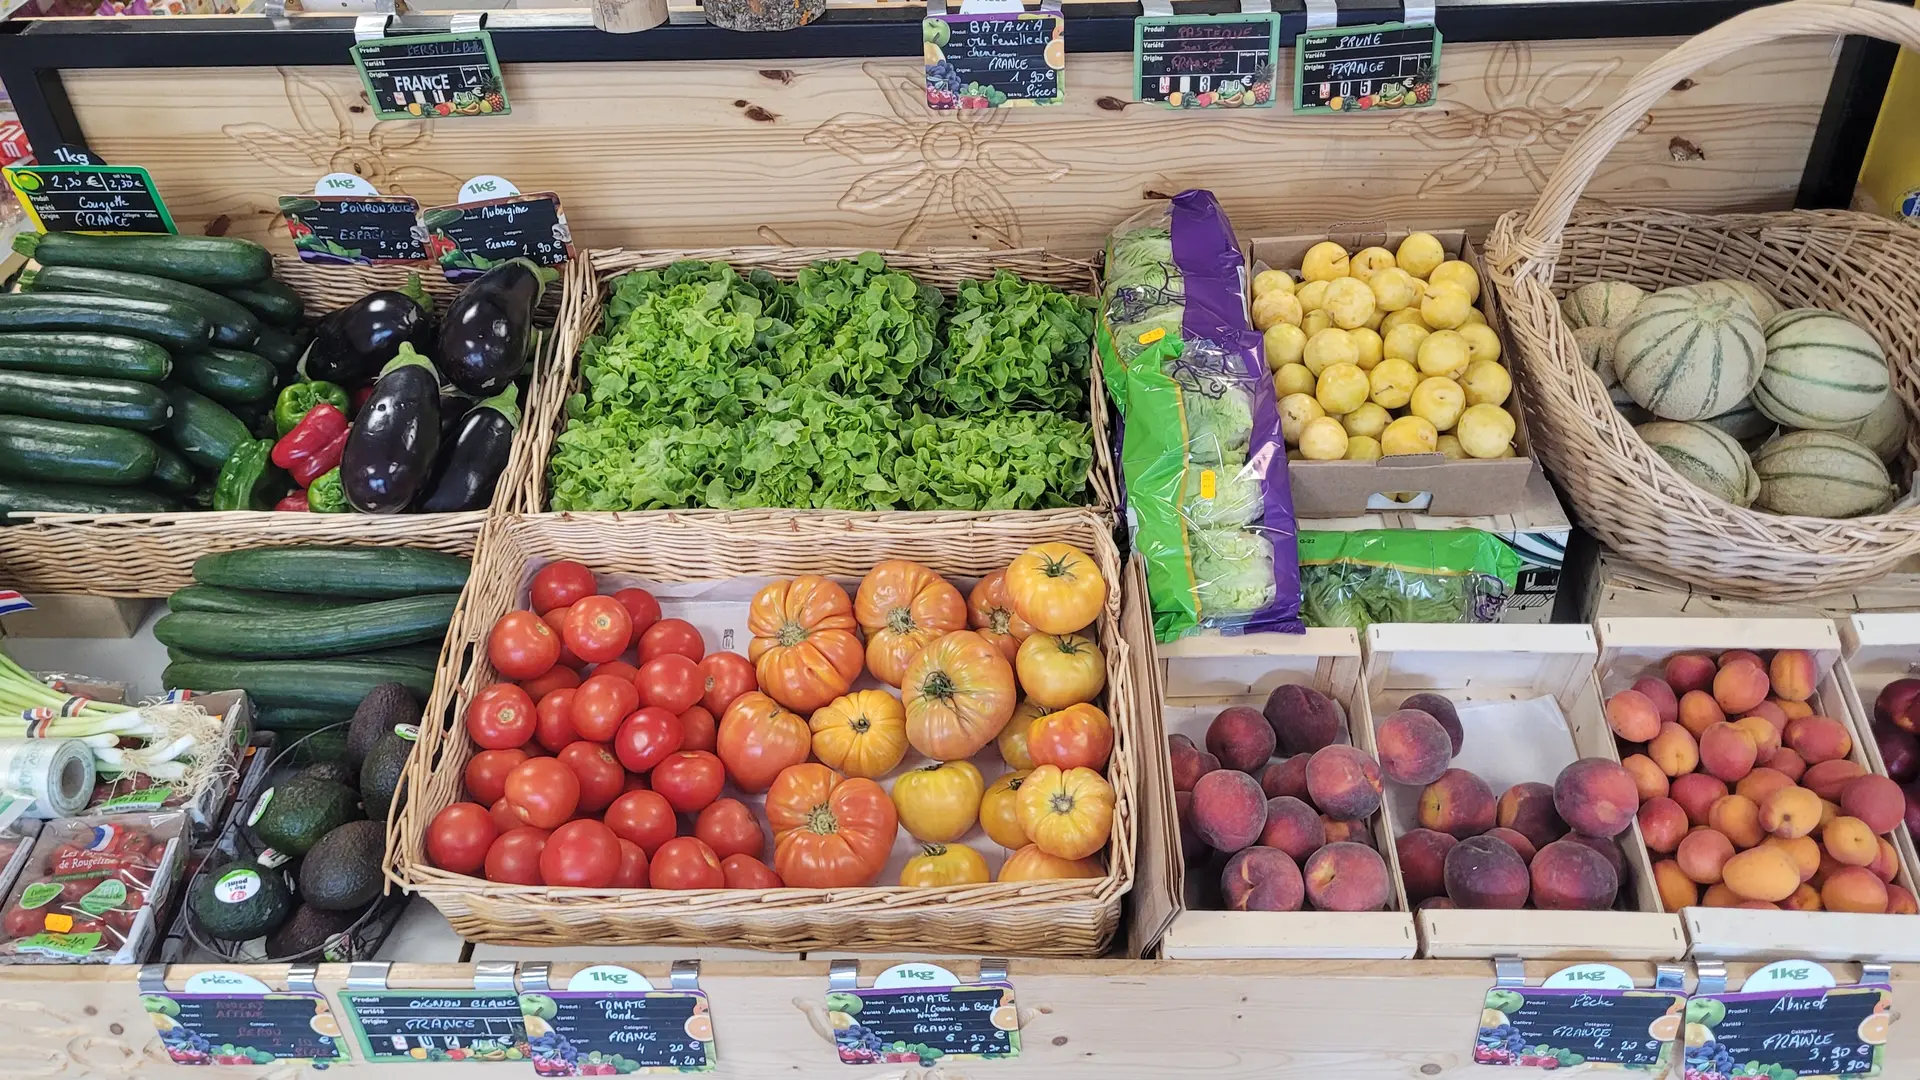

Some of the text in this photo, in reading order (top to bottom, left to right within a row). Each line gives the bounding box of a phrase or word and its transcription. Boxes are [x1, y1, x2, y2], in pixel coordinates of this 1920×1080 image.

[970, 20, 1042, 33] BATAVIA
[989, 58, 1028, 70] FRANCE
[1331, 61, 1385, 76] FRANCE
[394, 74, 450, 92] FRANCE
[54, 147, 89, 166] 1kg
[51, 175, 82, 190] 2,30
[86, 176, 104, 187] €
[326, 179, 355, 189] 1kg
[468, 180, 497, 195] 1kg
[340, 202, 386, 214] POIVRON
[75, 212, 130, 227] FRANCE
[485, 238, 517, 250] France
[590, 972, 628, 984] 1kg
[897, 970, 935, 980] 1kg
[1565, 970, 1606, 981] 1kg
[1768, 968, 1809, 980] 1kg
[471, 1000, 516, 1008] BLANC
[595, 999, 646, 1009] TOMATE
[900, 994, 951, 1004] TOMATE
[405, 1019, 475, 1030] FRANCE
[914, 1024, 963, 1033] FRANCE
[609, 1032, 657, 1042] FRANCE
[1553, 1028, 1611, 1037] FRANCE
[1763, 1033, 1834, 1049] FRANCE
